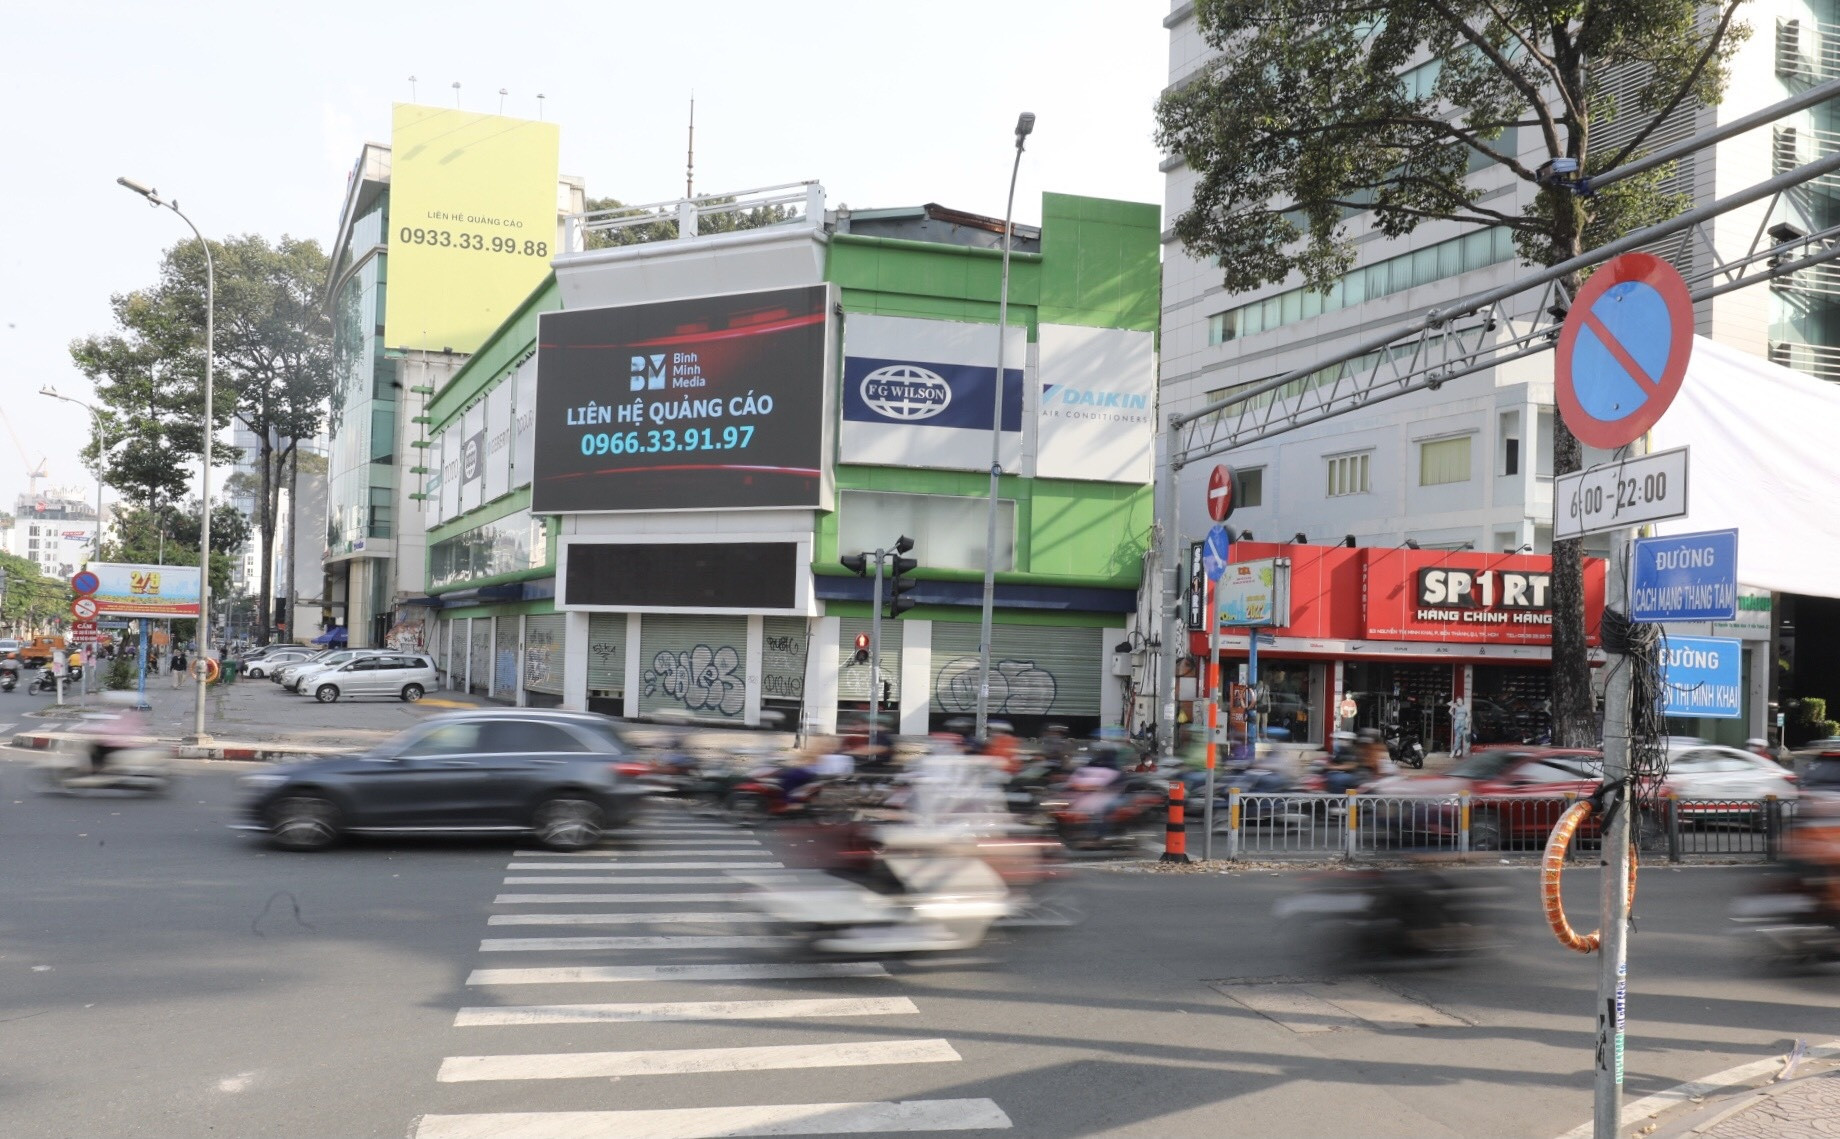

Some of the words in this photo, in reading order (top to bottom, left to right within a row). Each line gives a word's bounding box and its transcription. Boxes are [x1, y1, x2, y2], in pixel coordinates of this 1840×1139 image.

[427, 210, 449, 220] LIÊN
[400, 226, 548, 258] 0933.33.99.88
[672, 376, 706, 388] Media
[673, 364, 701, 376] Minh
[868, 384, 889, 396] FG
[891, 385, 945, 400] WILSON
[1062, 389, 1147, 409] DAIKIN
[567, 401, 612, 426] LIÊN
[617, 397, 644, 426] HỆ
[649, 394, 723, 424] QUẢNG
[729, 389, 774, 417] CÁO
[1066, 410, 1148, 424] CONDITIONERS
[581, 425, 755, 456] 0966.33.91.97
[1656, 545, 1715, 571] ĐƯỜNG
[1423, 569, 1550, 607] SP1RT
[1636, 581, 1657, 612] CÁCH
[1658, 587, 1683, 616] MẠNG
[1684, 578, 1713, 610] THÁNG
[1713, 576, 1733, 609] TÁM
[1675, 682, 1690, 711] THỊ
[1691, 682, 1715, 708] MINH
[1716, 684, 1738, 709] KHAI
